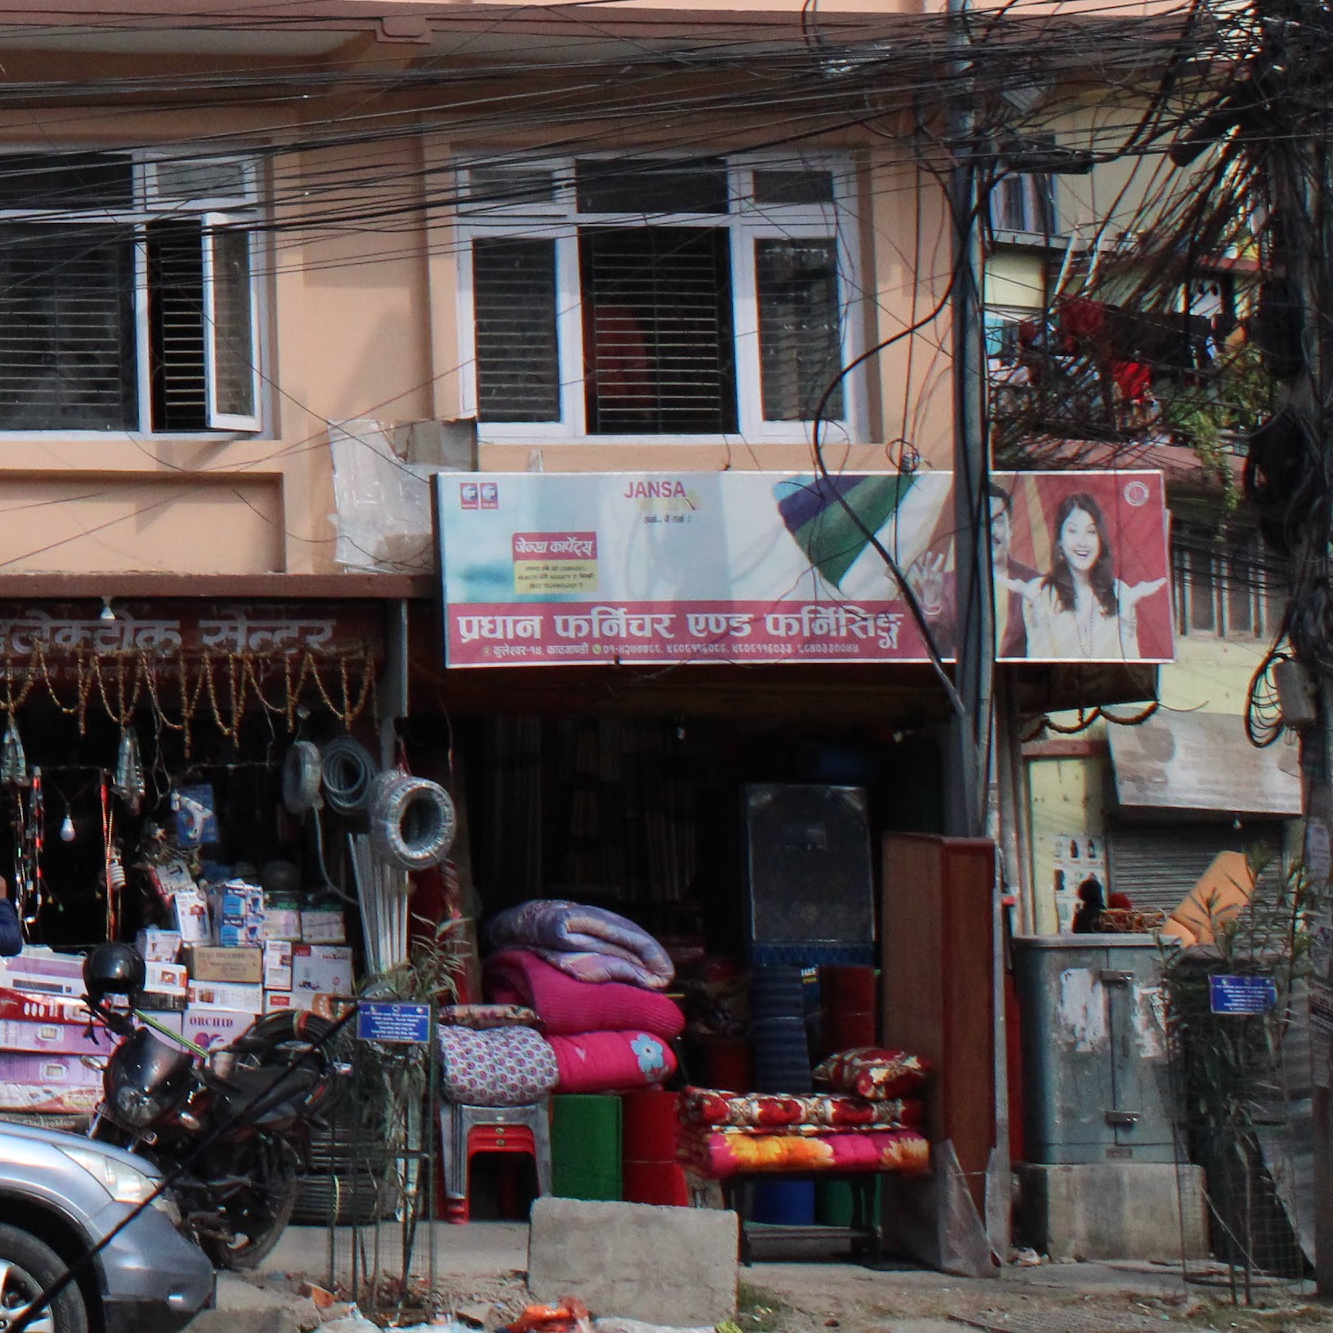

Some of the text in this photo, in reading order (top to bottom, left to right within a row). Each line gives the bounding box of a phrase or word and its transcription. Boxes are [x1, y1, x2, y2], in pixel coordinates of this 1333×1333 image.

[624, 480, 686, 499] JANSA
[457, 615, 544, 644] प्रधान
[552, 606, 677, 639] फर्निचर
[686, 614, 754, 638] एण्ड
[189, 1017, 233, 1028] ORCHID
